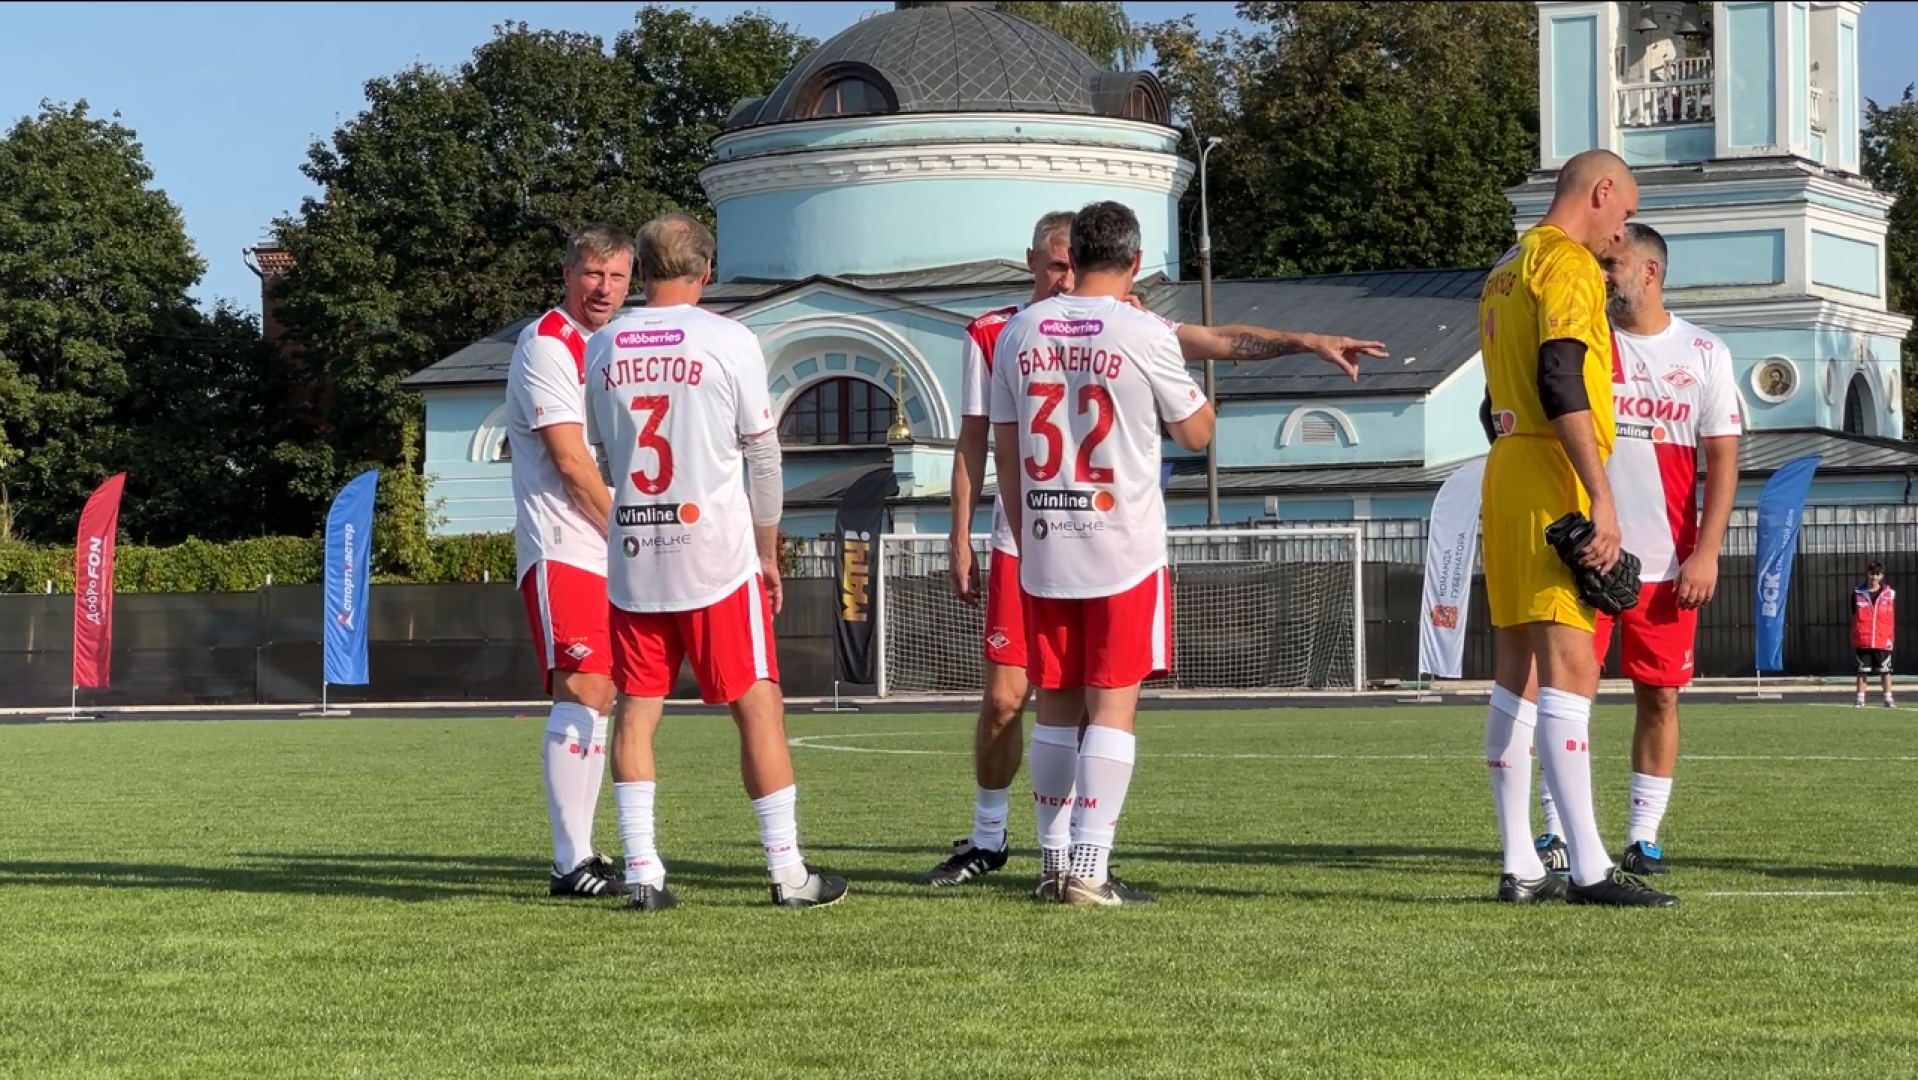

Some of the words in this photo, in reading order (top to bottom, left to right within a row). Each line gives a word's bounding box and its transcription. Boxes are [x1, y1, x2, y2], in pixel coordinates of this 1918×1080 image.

[619, 330, 681, 345] wildberries
[1042, 320, 1100, 334] wildberries
[602, 356, 703, 391] ХЛЕСТОВ
[1018, 346, 1123, 379] БАЖЕНОВ
[1613, 396, 1690, 423] КОЙЛ
[630, 394, 673, 495] 3
[1024, 382, 1114, 483] 32
[1616, 424, 1649, 439] inline
[618, 507, 674, 524] Winline
[1030, 493, 1088, 509] Winline
[641, 534, 692, 548] MELKE
[1050, 521, 1104, 531] MELKE
[843, 529, 870, 622] МАТЧ!
[1438, 549, 1452, 597] КОМАНДА
[1450, 532, 1466, 598] ГУБЕРНАТОРА
[1761, 571, 1781, 617] ВСК
